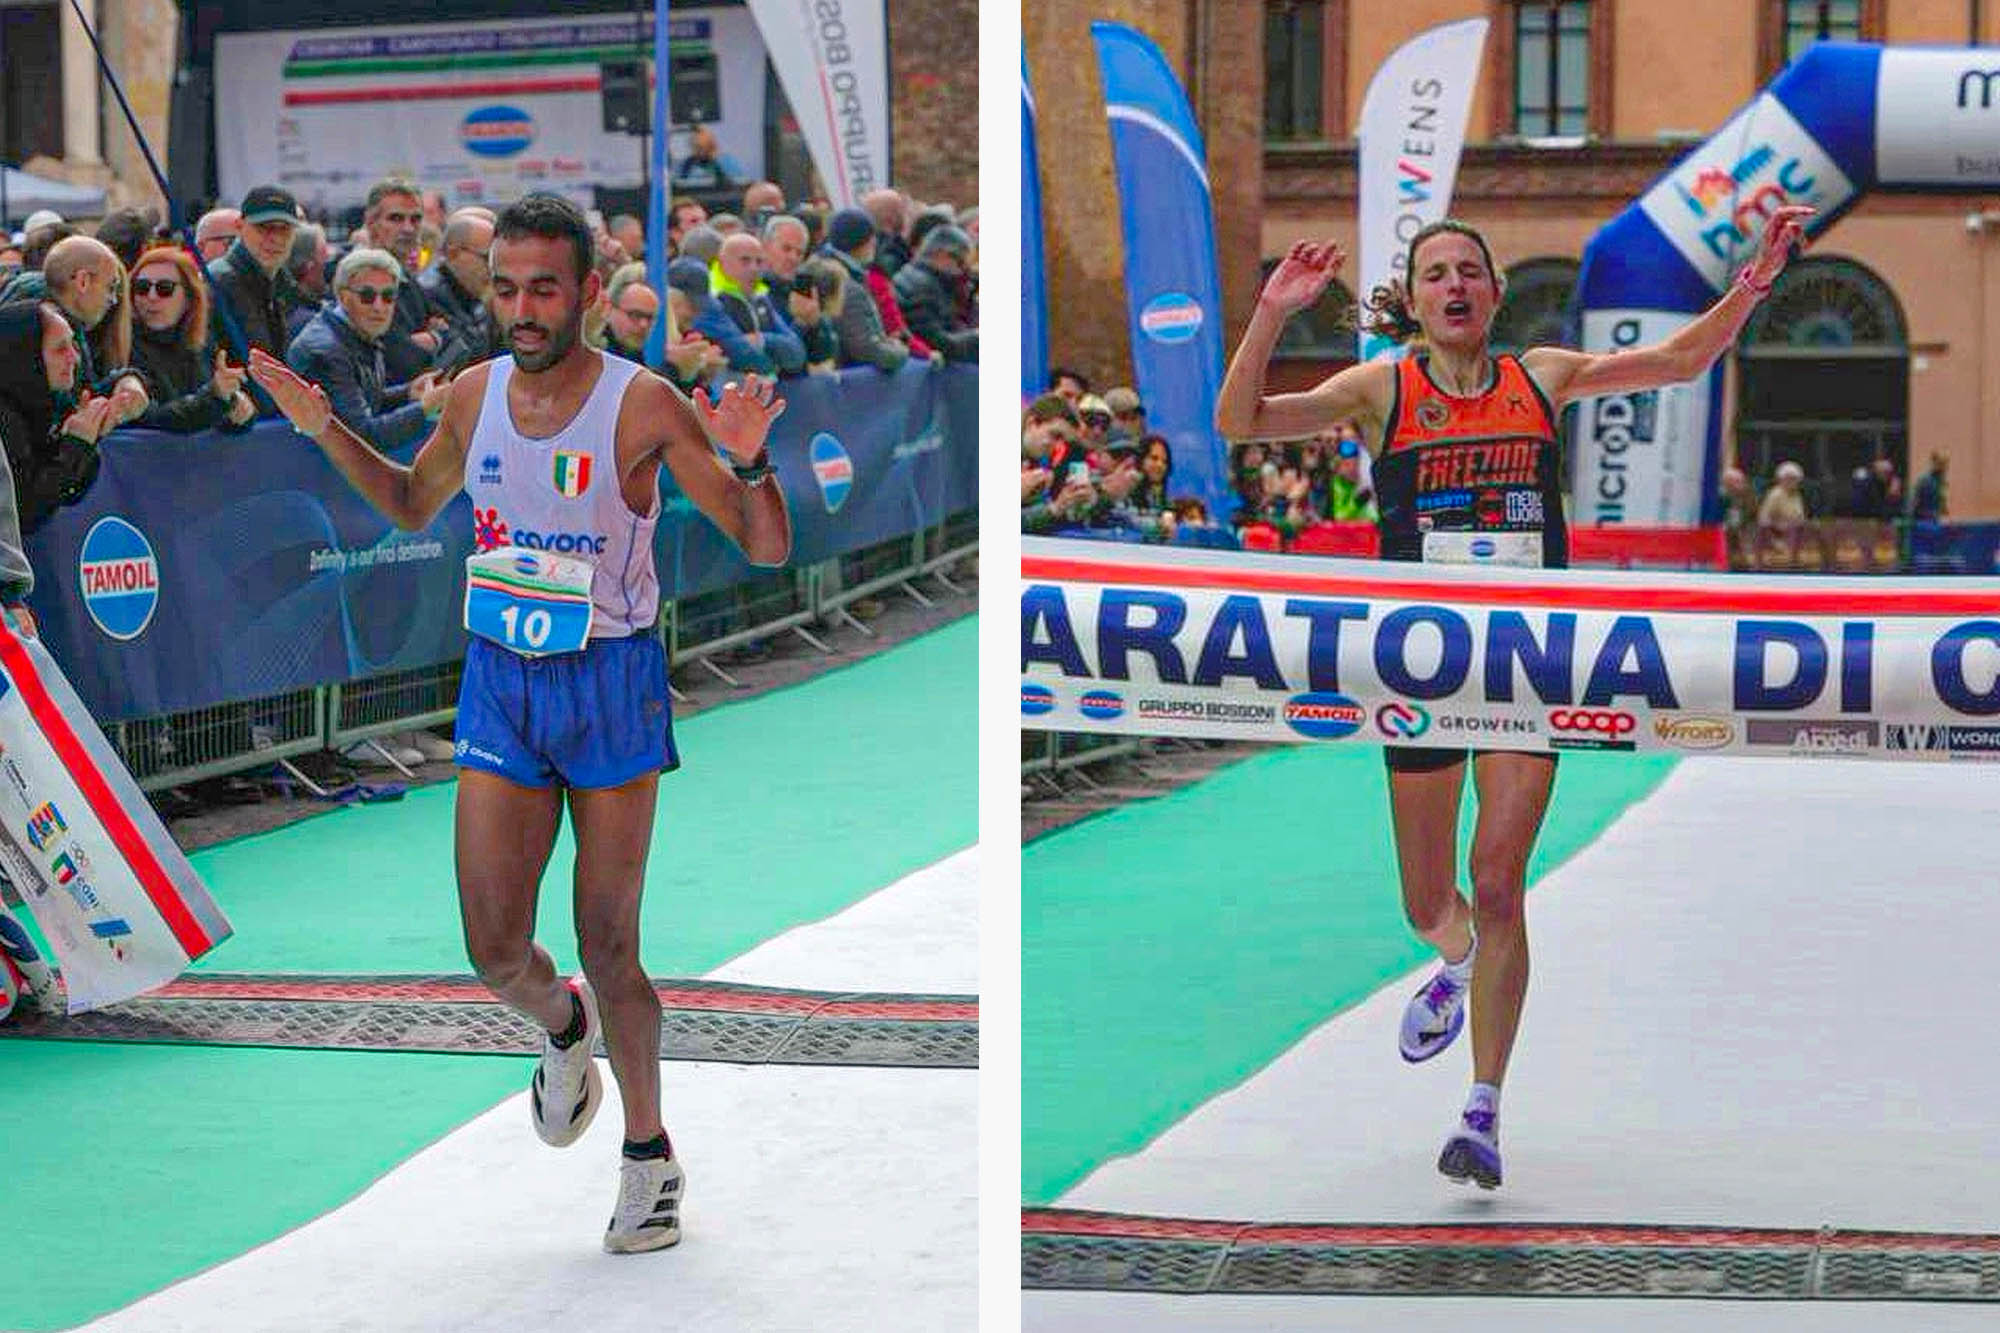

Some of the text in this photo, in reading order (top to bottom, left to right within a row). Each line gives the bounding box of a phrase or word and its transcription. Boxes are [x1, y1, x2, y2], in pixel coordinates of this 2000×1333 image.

[1391, 78, 1443, 270] ROWENS
[83, 560, 157, 595] TAMOIL
[500, 605, 552, 648] 10
[1734, 619, 1875, 713] DI
[1139, 699, 1204, 715] GRUPPO
[1206, 704, 1276, 720] BOSSONI
[1285, 704, 1364, 721] TAMOIL
[1439, 715, 1537, 734] GROWENS
[1551, 709, 1635, 743] coop
